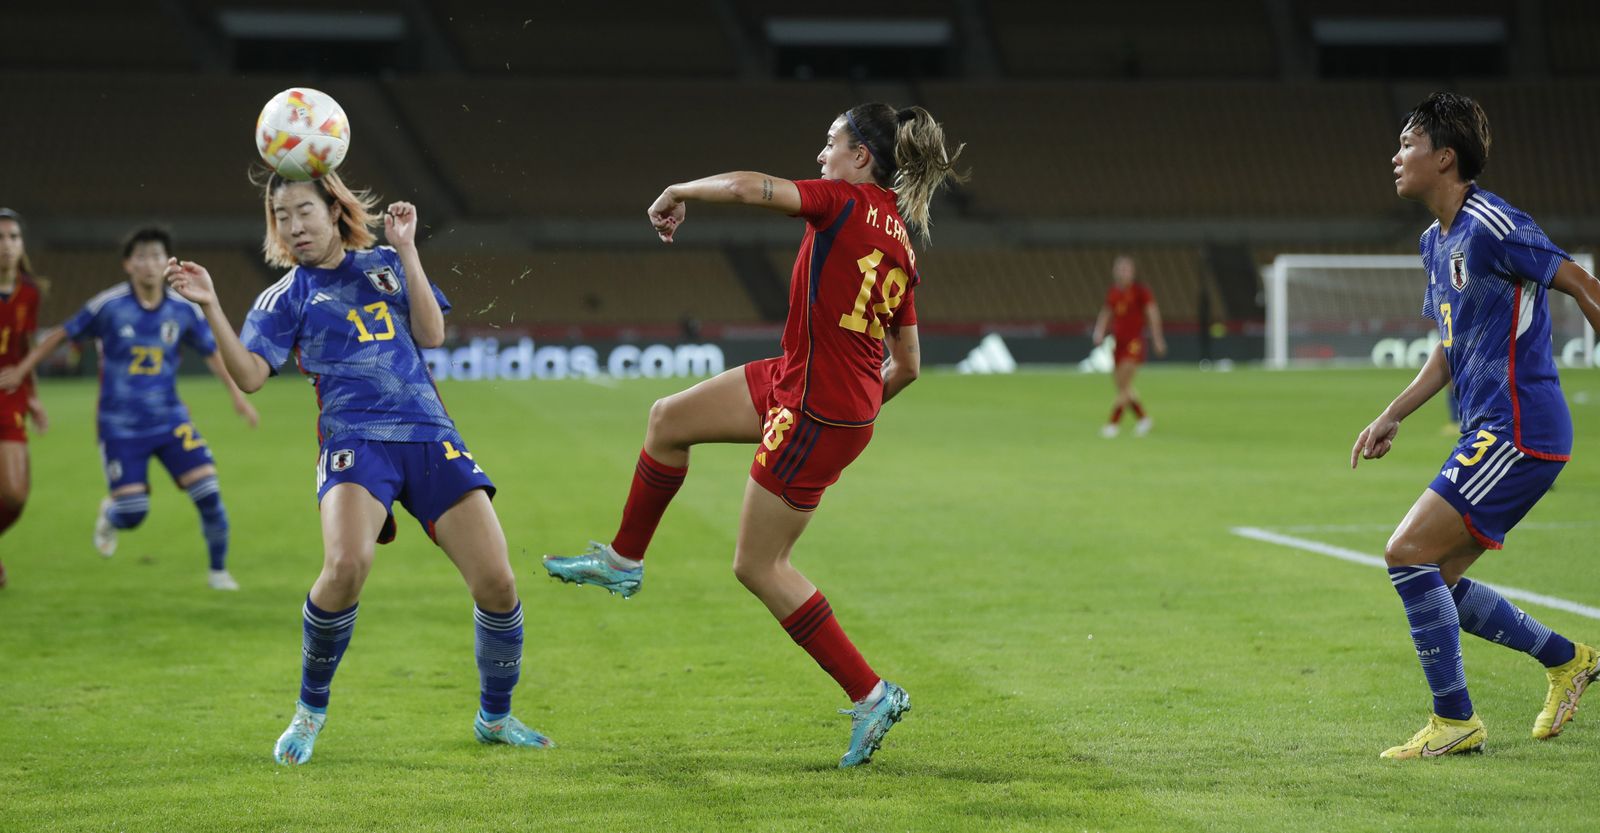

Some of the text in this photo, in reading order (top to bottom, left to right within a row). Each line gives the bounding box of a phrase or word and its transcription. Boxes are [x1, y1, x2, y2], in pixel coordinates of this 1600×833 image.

[866, 203, 880, 229] M.
[839, 248, 909, 340] 18
[346, 301, 395, 343] 13
[128, 346, 164, 375] 23
[422, 337, 724, 380] adidas.com
[1455, 429, 1497, 467] 3
